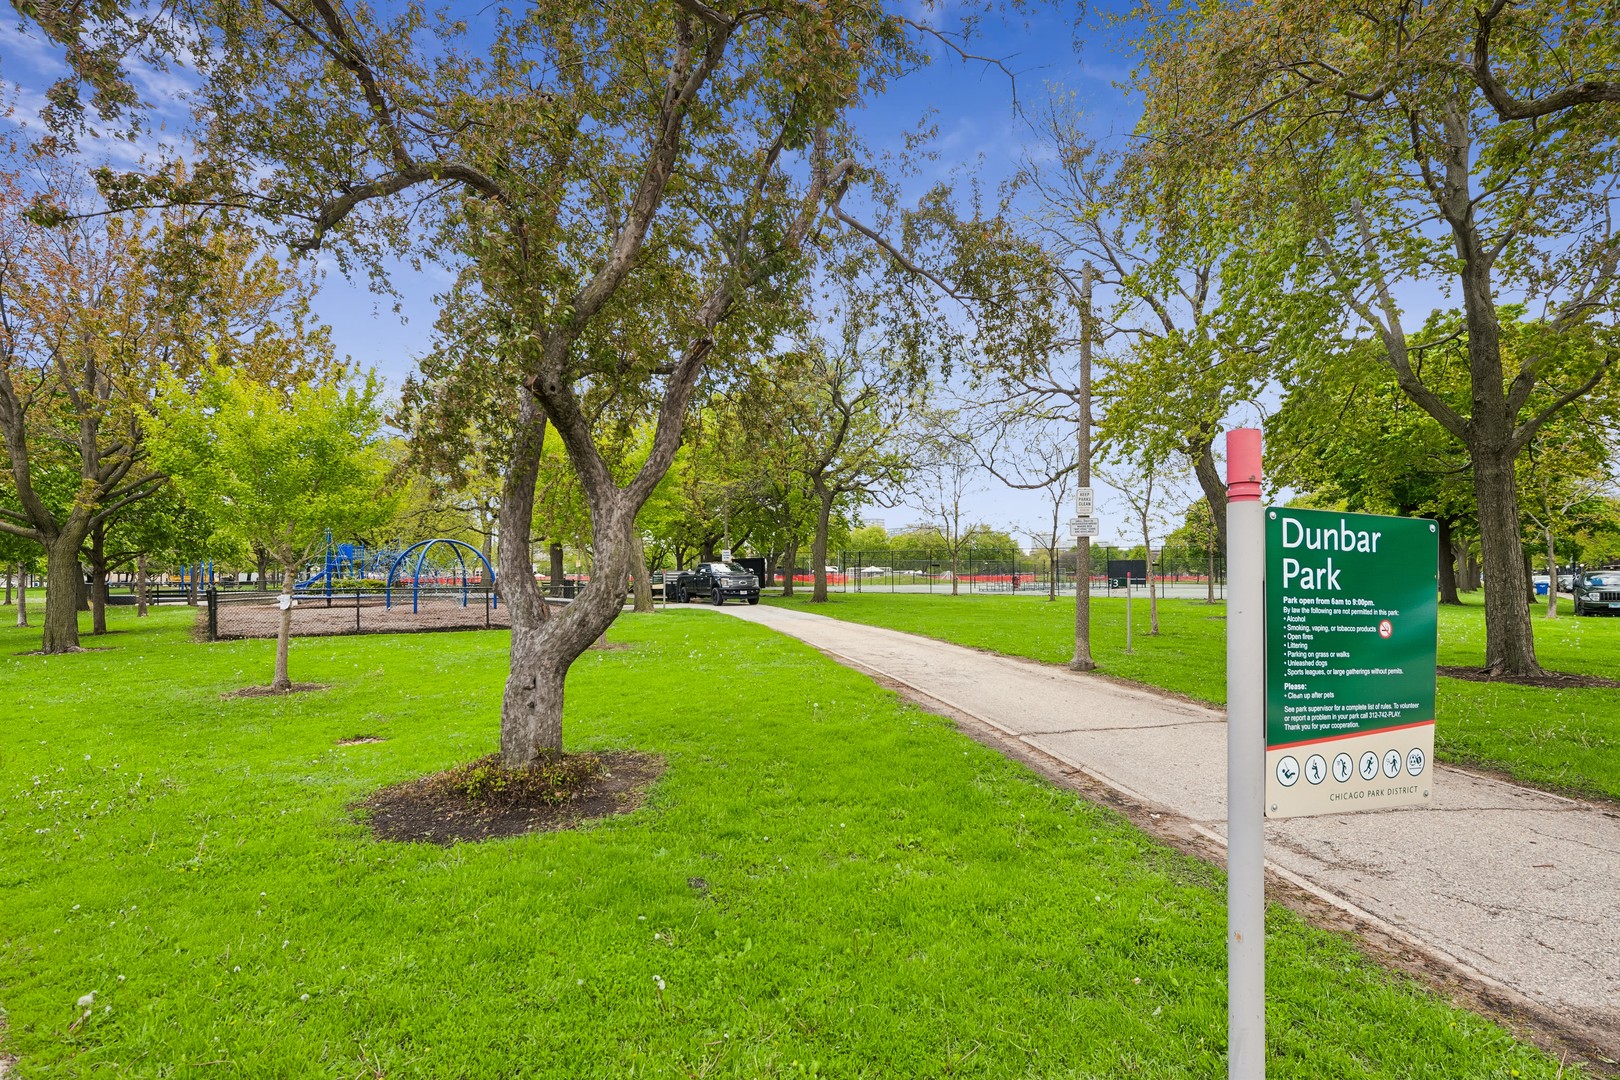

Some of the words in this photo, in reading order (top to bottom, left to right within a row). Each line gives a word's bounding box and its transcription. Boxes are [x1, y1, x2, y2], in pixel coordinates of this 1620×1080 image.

[1282, 518, 1381, 552] Dunbar
[1283, 558, 1341, 590] Park
[1112, 579, 1118, 587] 3
[1352, 598, 1375, 607] 9:00pm.
[1283, 606, 1290, 614] By
[1310, 607, 1332, 615] following
[1287, 624, 1310, 632] Smoking,
[1287, 633, 1302, 641] Open
[1287, 642, 1308, 650] Littering
[1288, 651, 1307, 659] Parking
[1287, 668, 1304, 676] Sports
[1332, 668, 1345, 676] large
[1308, 704, 1333, 713] supervisor
[1346, 704, 1367, 712] complete
[1290, 714, 1306, 722] report
[1312, 714, 1332, 722] problem
[1348, 712, 1360, 720] park
[1301, 724, 1310, 732] you
[1330, 722, 1360, 730] cooperation.
[1330, 791, 1364, 801] CHICAGO
[1368, 789, 1384, 798] PARK
[1388, 786, 1418, 795] DISTRICT
